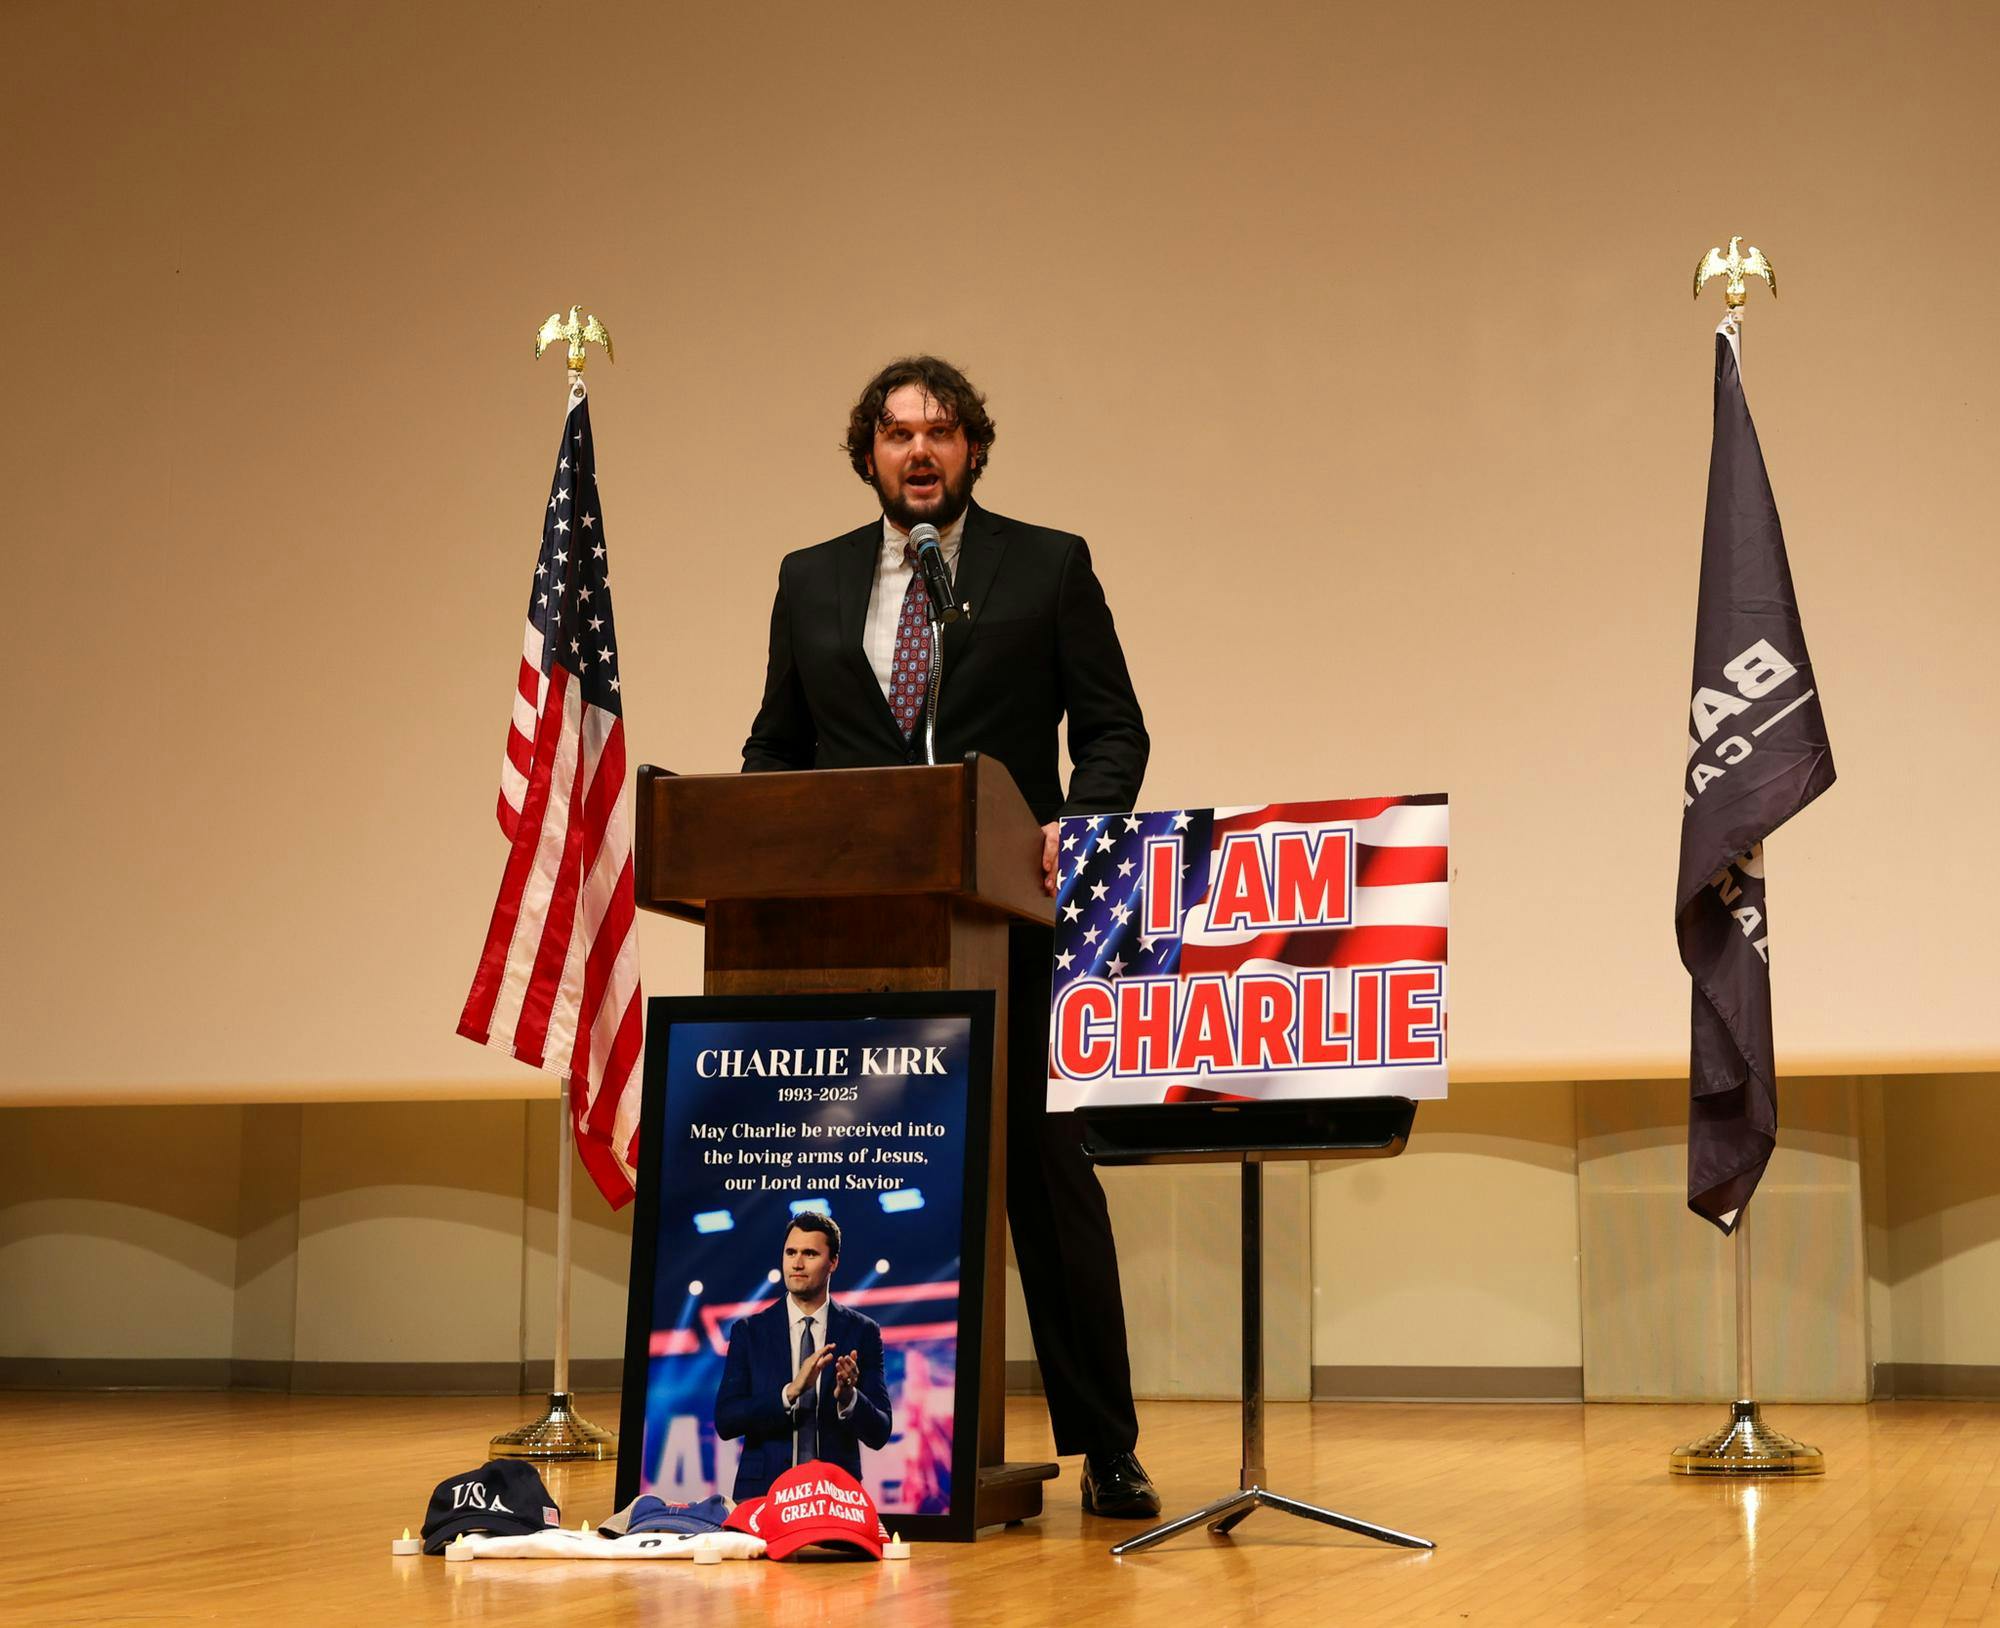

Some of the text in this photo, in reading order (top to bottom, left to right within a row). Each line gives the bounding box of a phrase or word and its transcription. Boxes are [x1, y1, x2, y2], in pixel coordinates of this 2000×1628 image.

[1145, 828, 1353, 935] I AM
[1055, 965, 1442, 1081] CHARLIE
[695, 1047, 947, 1079] CHARLIE KIRK
[777, 1086, 858, 1102] 1993-2025
[690, 1121, 945, 1142] May Charlie be received into
[704, 1148, 929, 1168] the loving arms of Jesus,
[725, 1173, 904, 1190] our Lord and Savior
[452, 1481, 514, 1514] USA
[774, 1479, 869, 1507] MAKE AMERICA
[781, 1499, 827, 1524] GREAT
[828, 1501, 866, 1523] AGAIN
